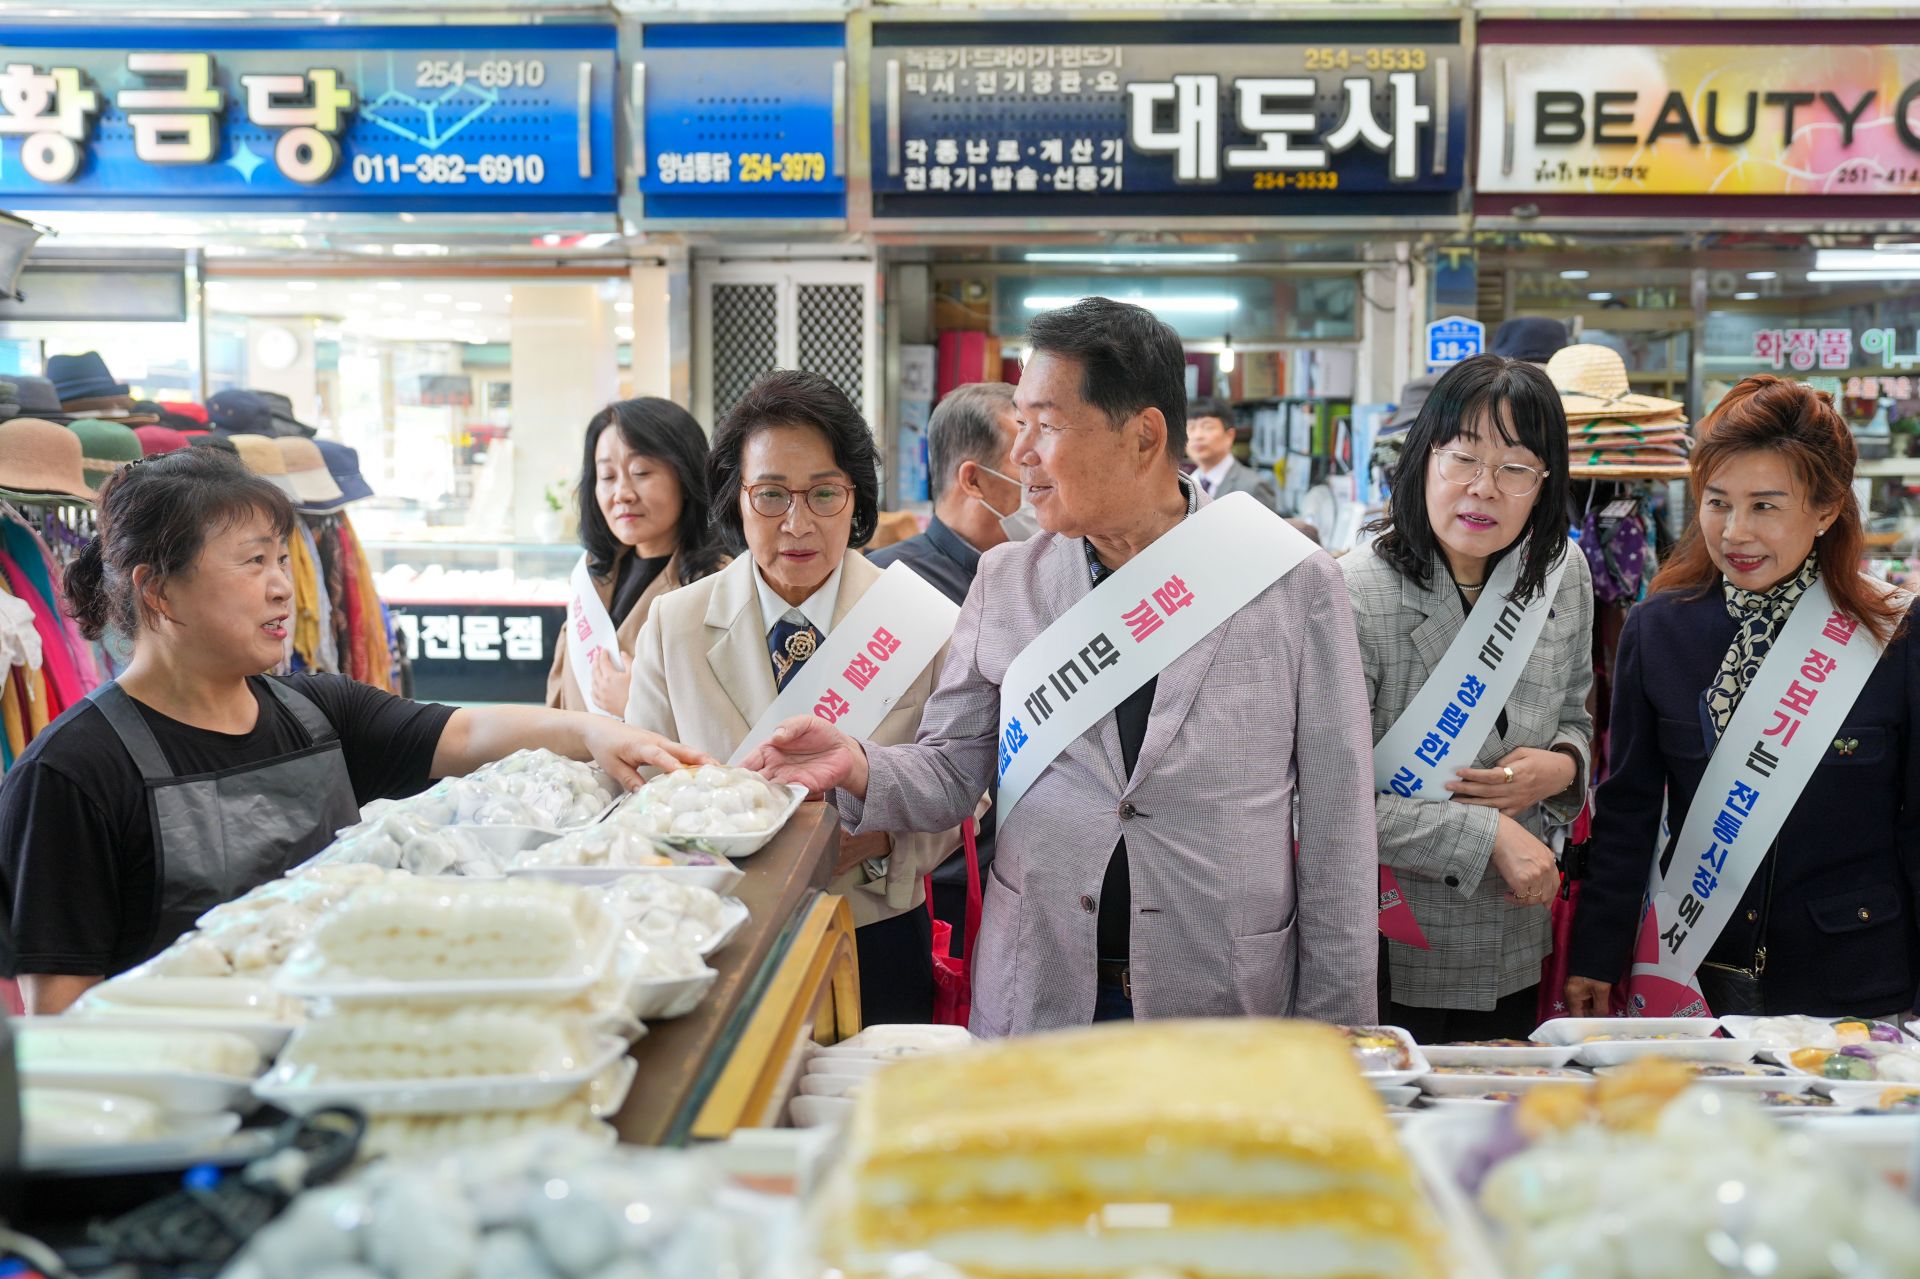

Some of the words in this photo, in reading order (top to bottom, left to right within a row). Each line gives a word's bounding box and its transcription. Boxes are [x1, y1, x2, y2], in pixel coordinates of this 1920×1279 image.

[415, 60, 545, 88] 254-6910
[1303, 48, 1427, 71] 254-3533
[0, 53, 351, 183] 황금당
[1126, 72, 1431, 180] 대도사
[1534, 91, 1878, 148] BEAUTY
[352, 153, 545, 184] 011-362-6910
[657, 151, 732, 183] 양념통닭
[738, 152, 826, 182] 254-3979
[1253, 171, 1339, 190] 254-3533
[1753, 328, 1852, 371] 화장품
[1121, 574, 1195, 644] 함께
[1478, 594, 1530, 671] 드는
[842, 626, 902, 691] 명절
[1024, 632, 1121, 726] 만드는
[1414, 674, 1487, 768] 청렴한
[1746, 648, 1837, 778] 장보기는
[1660, 780, 1760, 955] 전통시장에서
